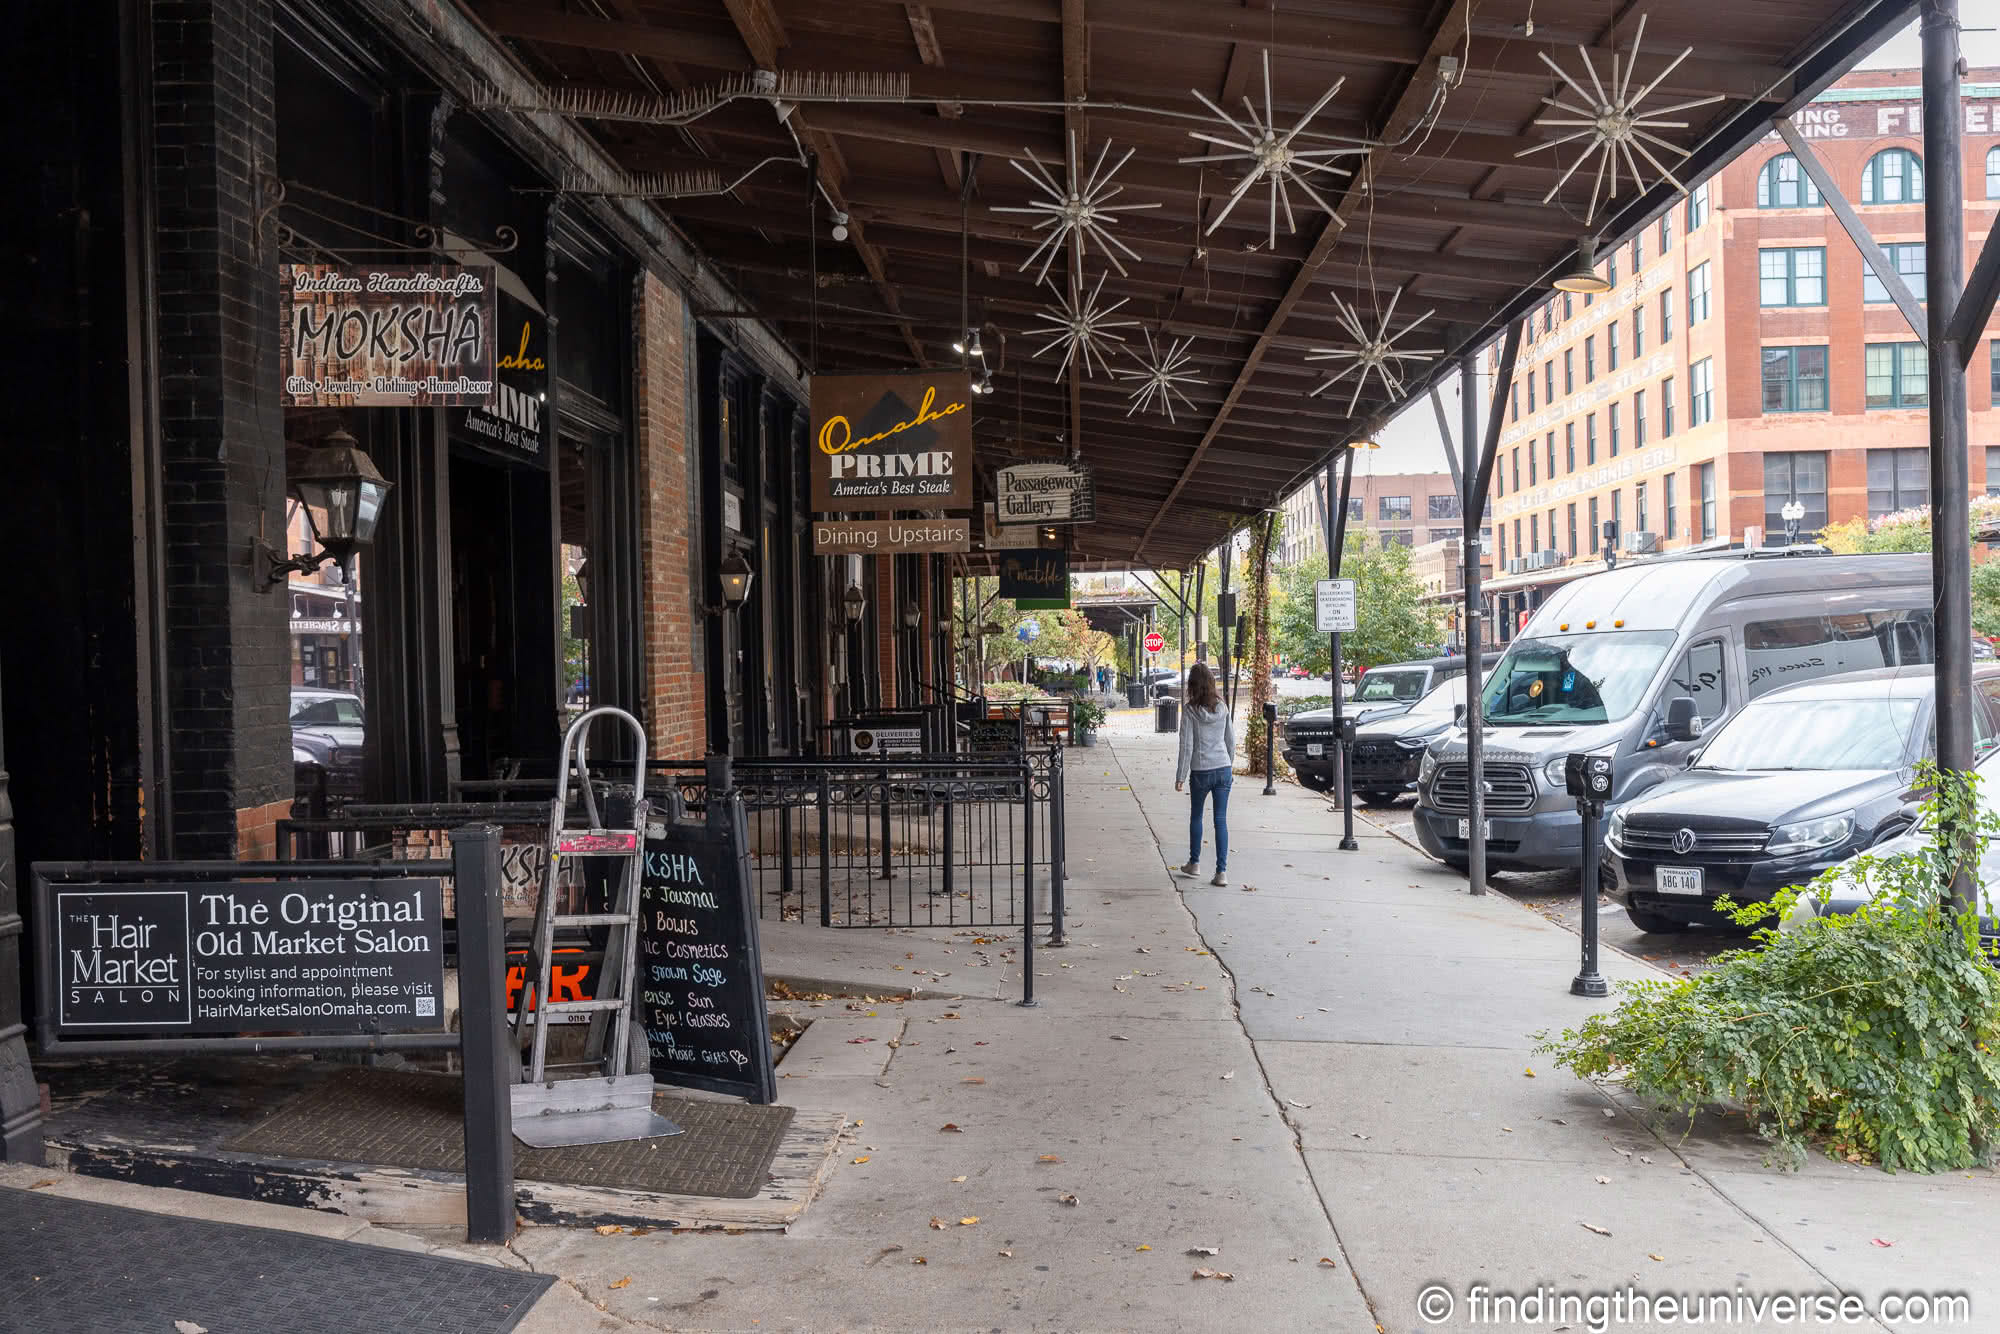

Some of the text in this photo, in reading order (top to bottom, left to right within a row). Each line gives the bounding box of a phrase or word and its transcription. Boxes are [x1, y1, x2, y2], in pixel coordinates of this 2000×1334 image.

[1788, 109, 1841, 124] ING
[295, 272, 483, 296] Indian Handicrafts
[296, 303, 483, 366] MOKSHA
[496, 321, 544, 370] aha
[286, 376, 493, 395] Gifts Jewelry Clothing Home Decor
[465, 408, 539, 454] America's Best Steak
[818, 386, 966, 455] Omaha
[829, 451, 953, 479] PRIME
[833, 480, 951, 496] America's Best Steak
[1005, 471, 1085, 495] Passageway
[1005, 495, 1056, 517] Gallery
[817, 525, 964, 547] Dining Upstairs
[1145, 637, 1163, 647] STOP
[645, 849, 704, 886] KSHA
[1663, 875, 1696, 890] ABG 140
[69, 914, 89, 922] THE
[200, 890, 425, 930] The Original
[90, 914, 158, 949] Hair
[196, 929, 430, 956] Old Market Salon
[666, 941, 729, 959] Cosmetics
[71, 949, 179, 984] Market
[197, 963, 393, 982] For stylist and appointment
[651, 963, 727, 988] grown Sage
[71, 989, 180, 1004] SALON
[198, 981, 433, 1001] booking information, please visit
[644, 990, 674, 1005] ense
[687, 992, 714, 1009] Sun
[198, 1002, 411, 1018] HairMarketSalonOmaha.com.
[568, 1014, 586, 1023] one
[701, 1049, 729, 1065] Gifts
